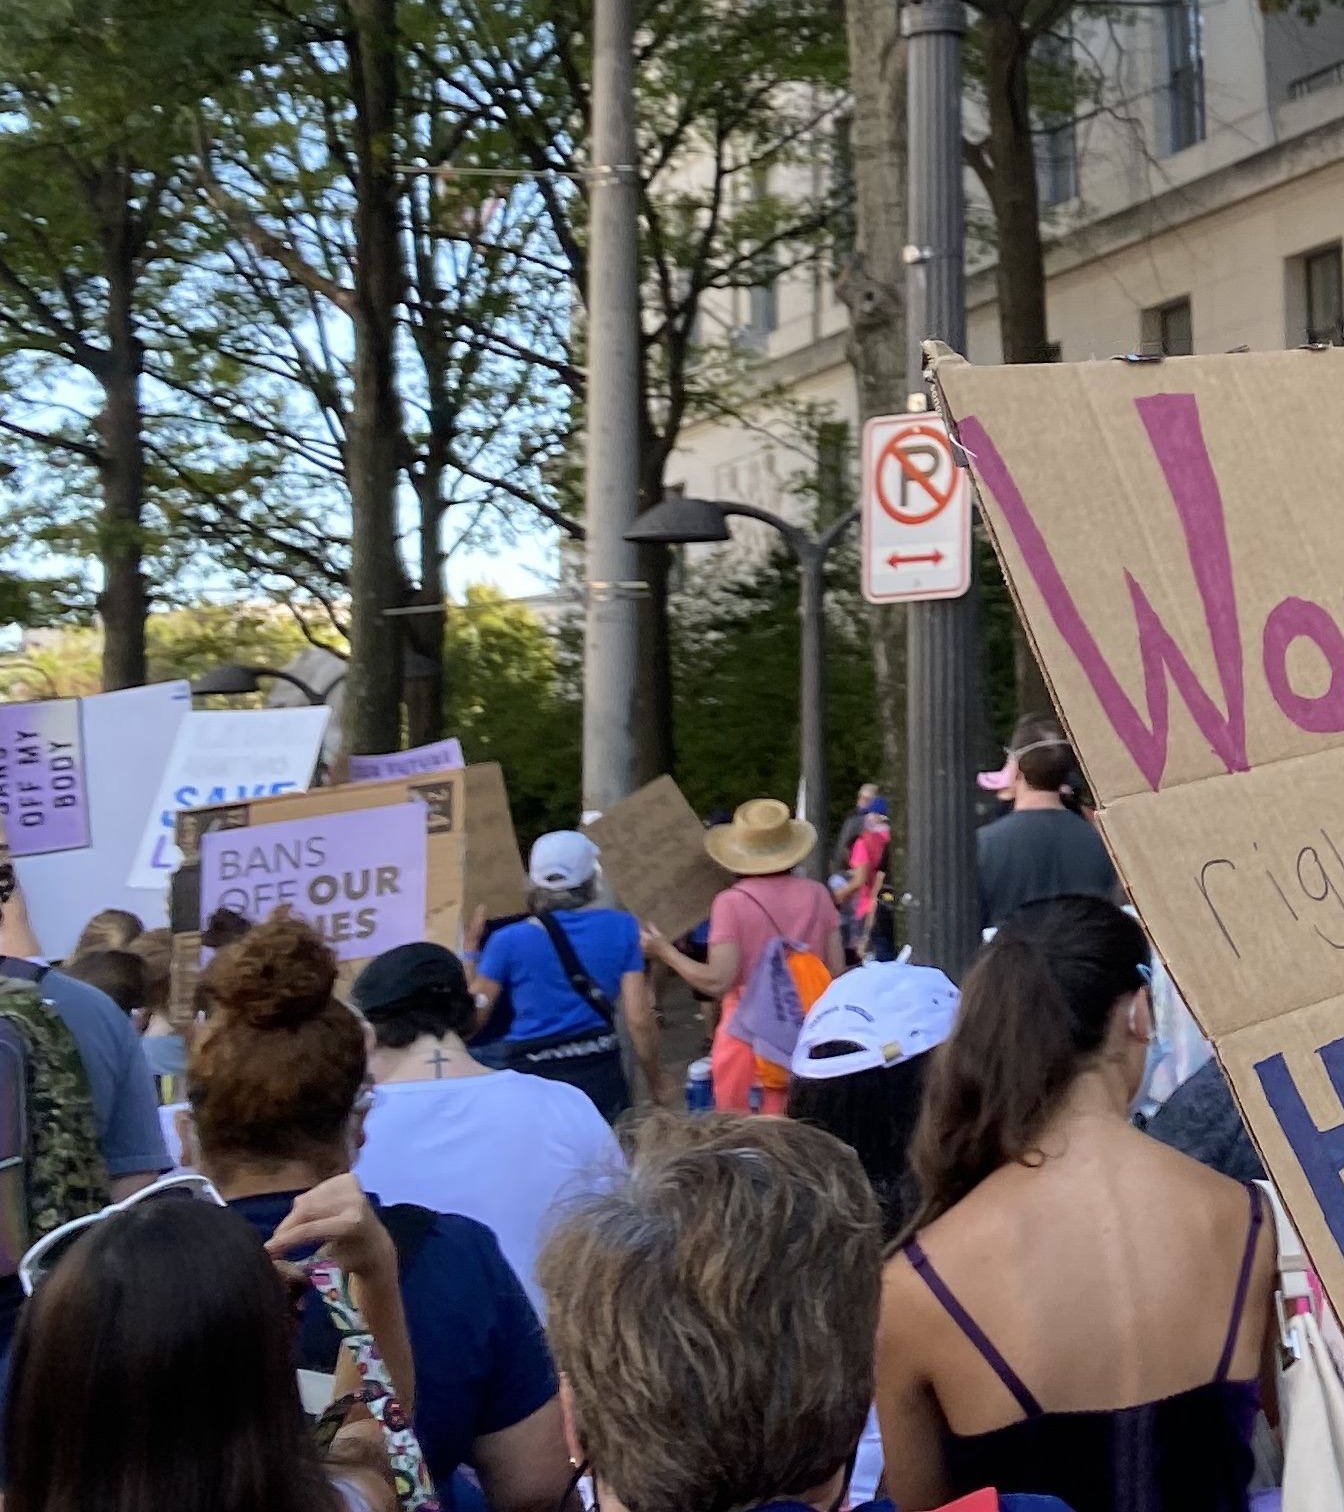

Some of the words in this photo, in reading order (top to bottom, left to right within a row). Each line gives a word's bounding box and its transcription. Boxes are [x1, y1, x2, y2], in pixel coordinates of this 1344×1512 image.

[16, 731, 40, 764] MY
[49, 741, 76, 808] BODY
[18, 781, 44, 826] OFF
[220, 837, 326, 881] BANS
[218, 879, 298, 915] OFF
[309, 866, 401, 905] OUR
